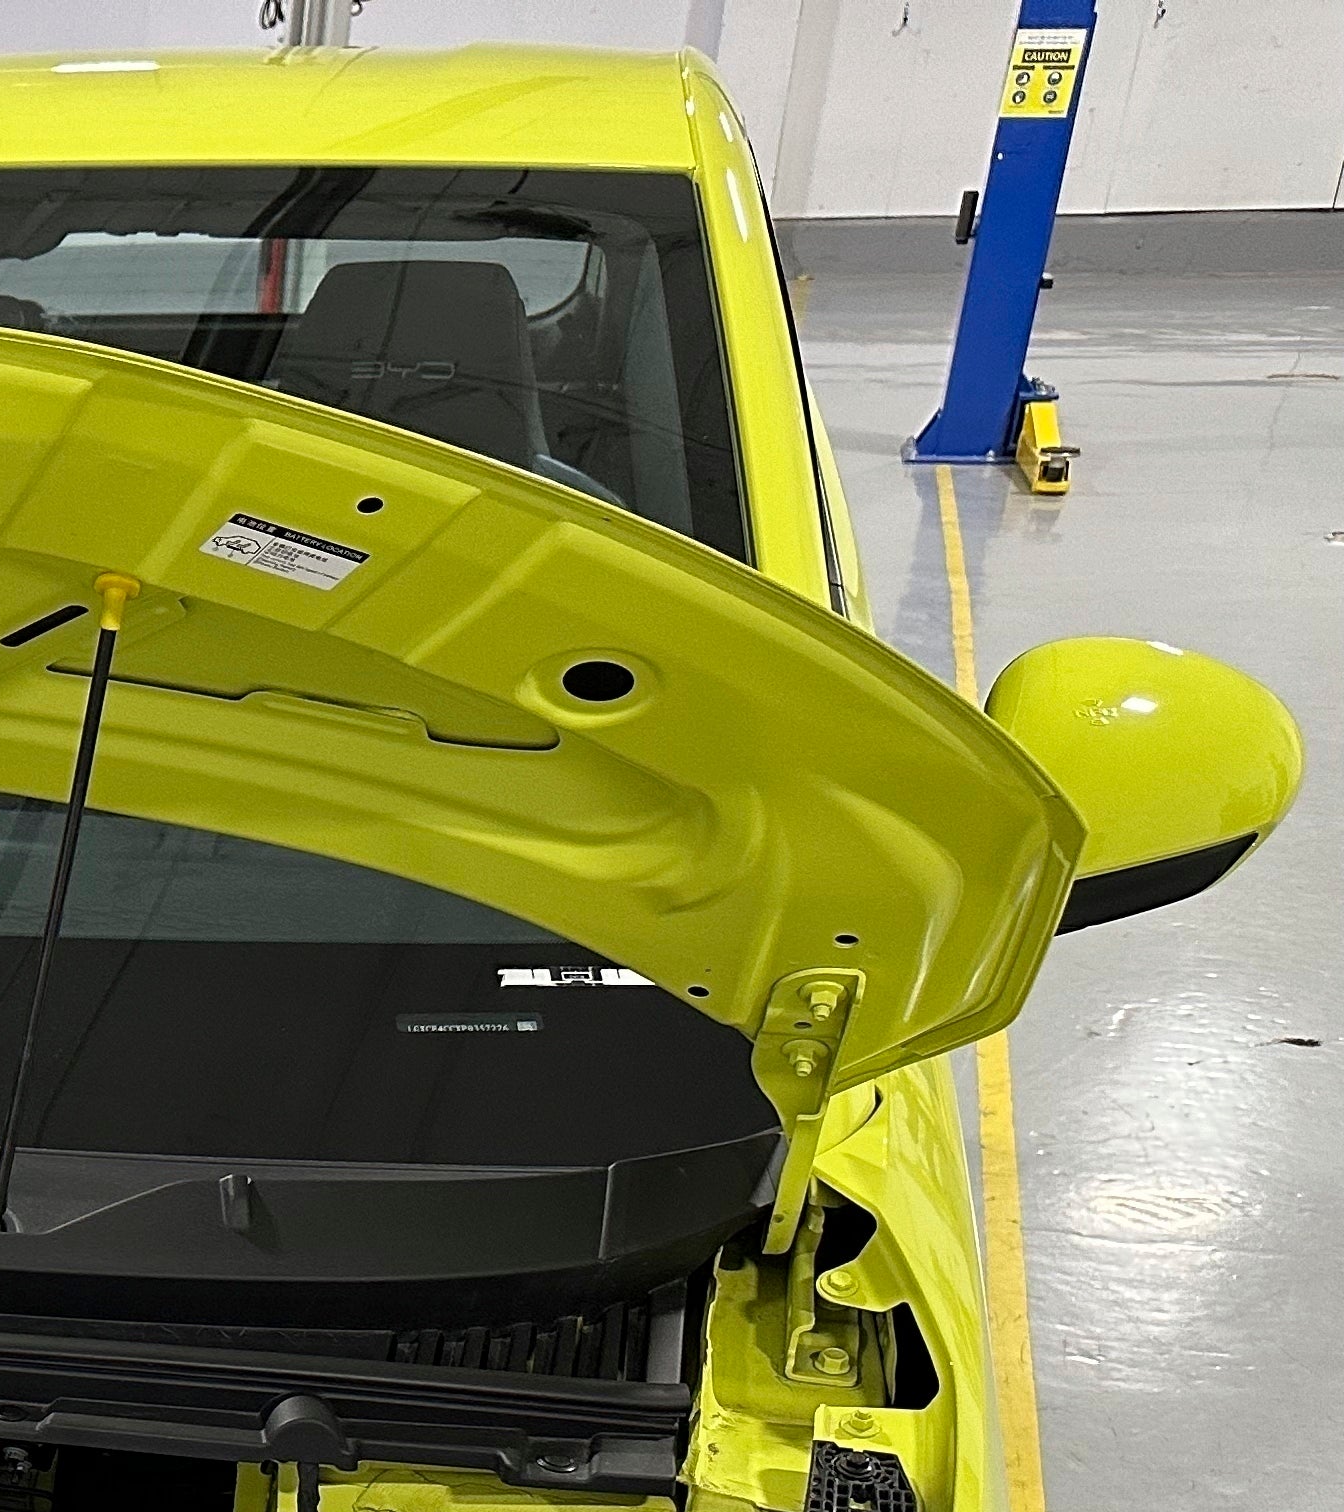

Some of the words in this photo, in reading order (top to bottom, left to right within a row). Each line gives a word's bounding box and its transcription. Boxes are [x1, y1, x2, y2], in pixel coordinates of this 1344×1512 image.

[1024, 51, 1068, 61] CAUTION
[351, 361, 455, 379] BYD
[283, 531, 321, 548] BATTERY
[320, 542, 363, 561] LOCATION
